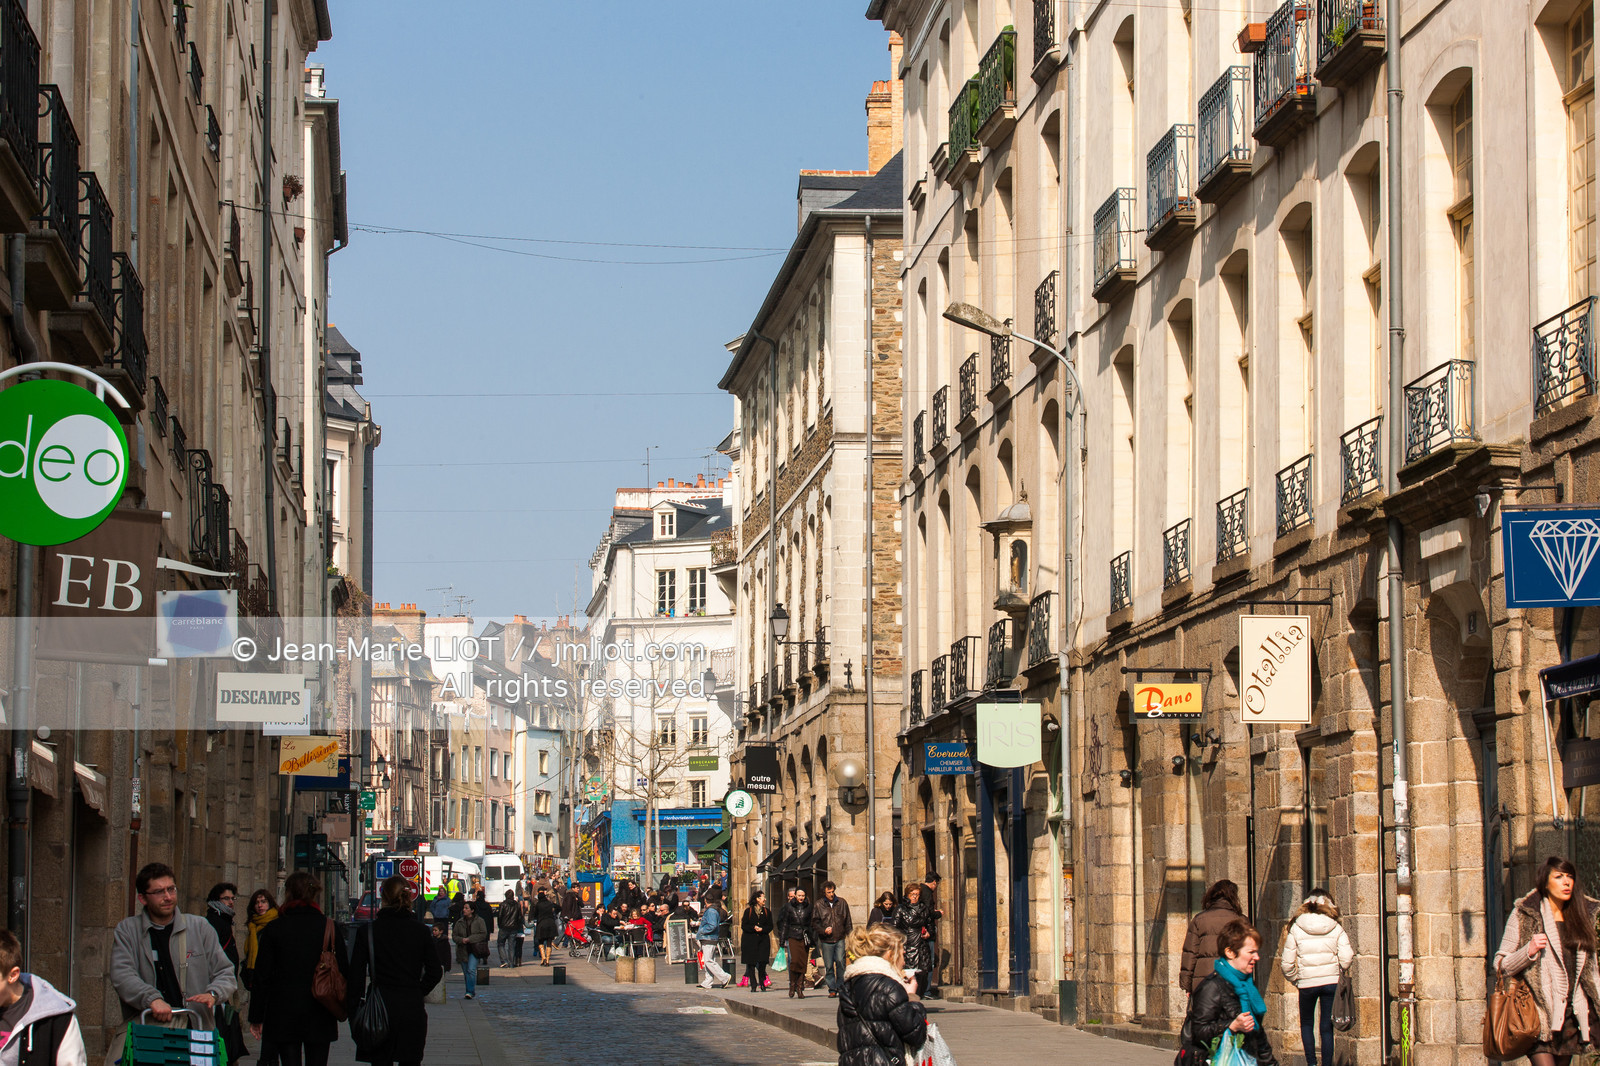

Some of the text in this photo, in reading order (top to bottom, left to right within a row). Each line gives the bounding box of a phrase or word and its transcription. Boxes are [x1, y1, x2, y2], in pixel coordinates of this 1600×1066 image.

[52, 553, 142, 612] EB
[1245, 623, 1306, 715] Otallia
[220, 688, 301, 706] DESCAMPS
[1136, 686, 1192, 712] Dano
[282, 740, 296, 750] La
[982, 721, 1036, 748] IRIS
[282, 742, 337, 774] Bellissime
